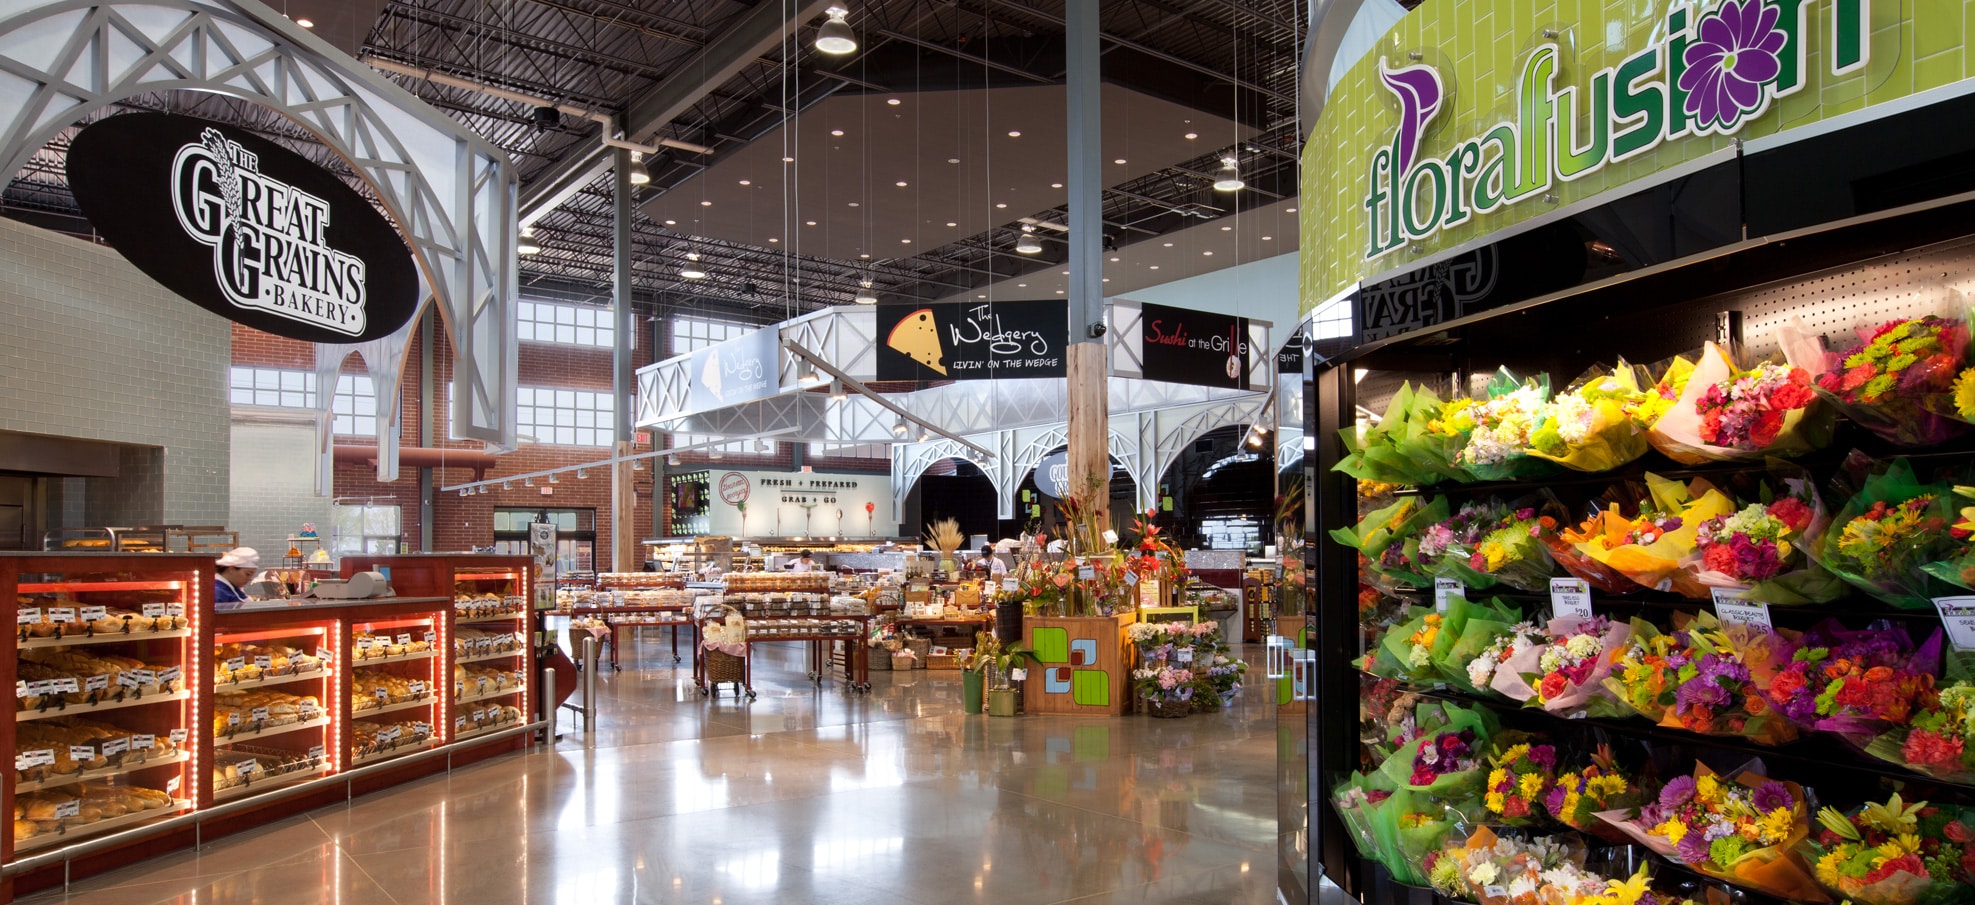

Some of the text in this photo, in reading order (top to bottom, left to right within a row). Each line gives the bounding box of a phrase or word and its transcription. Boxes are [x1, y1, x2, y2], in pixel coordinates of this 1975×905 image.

[231, 147, 257, 169] THE
[178, 152, 325, 244] GREAT
[221, 229, 361, 304] GRAINS
[969, 304, 992, 322] The
[950, 314, 1048, 356] Wedgery
[1145, 320, 1187, 347] Sushi
[1188, 339, 1196, 348] at
[1199, 340, 1210, 350] the
[953, 358, 1058, 369] LIVIN' ON THE WEDGE
[760, 478, 792, 487] FRESH
[809, 480, 858, 489] PREPARED
[1575, 608, 1589, 618] $20
